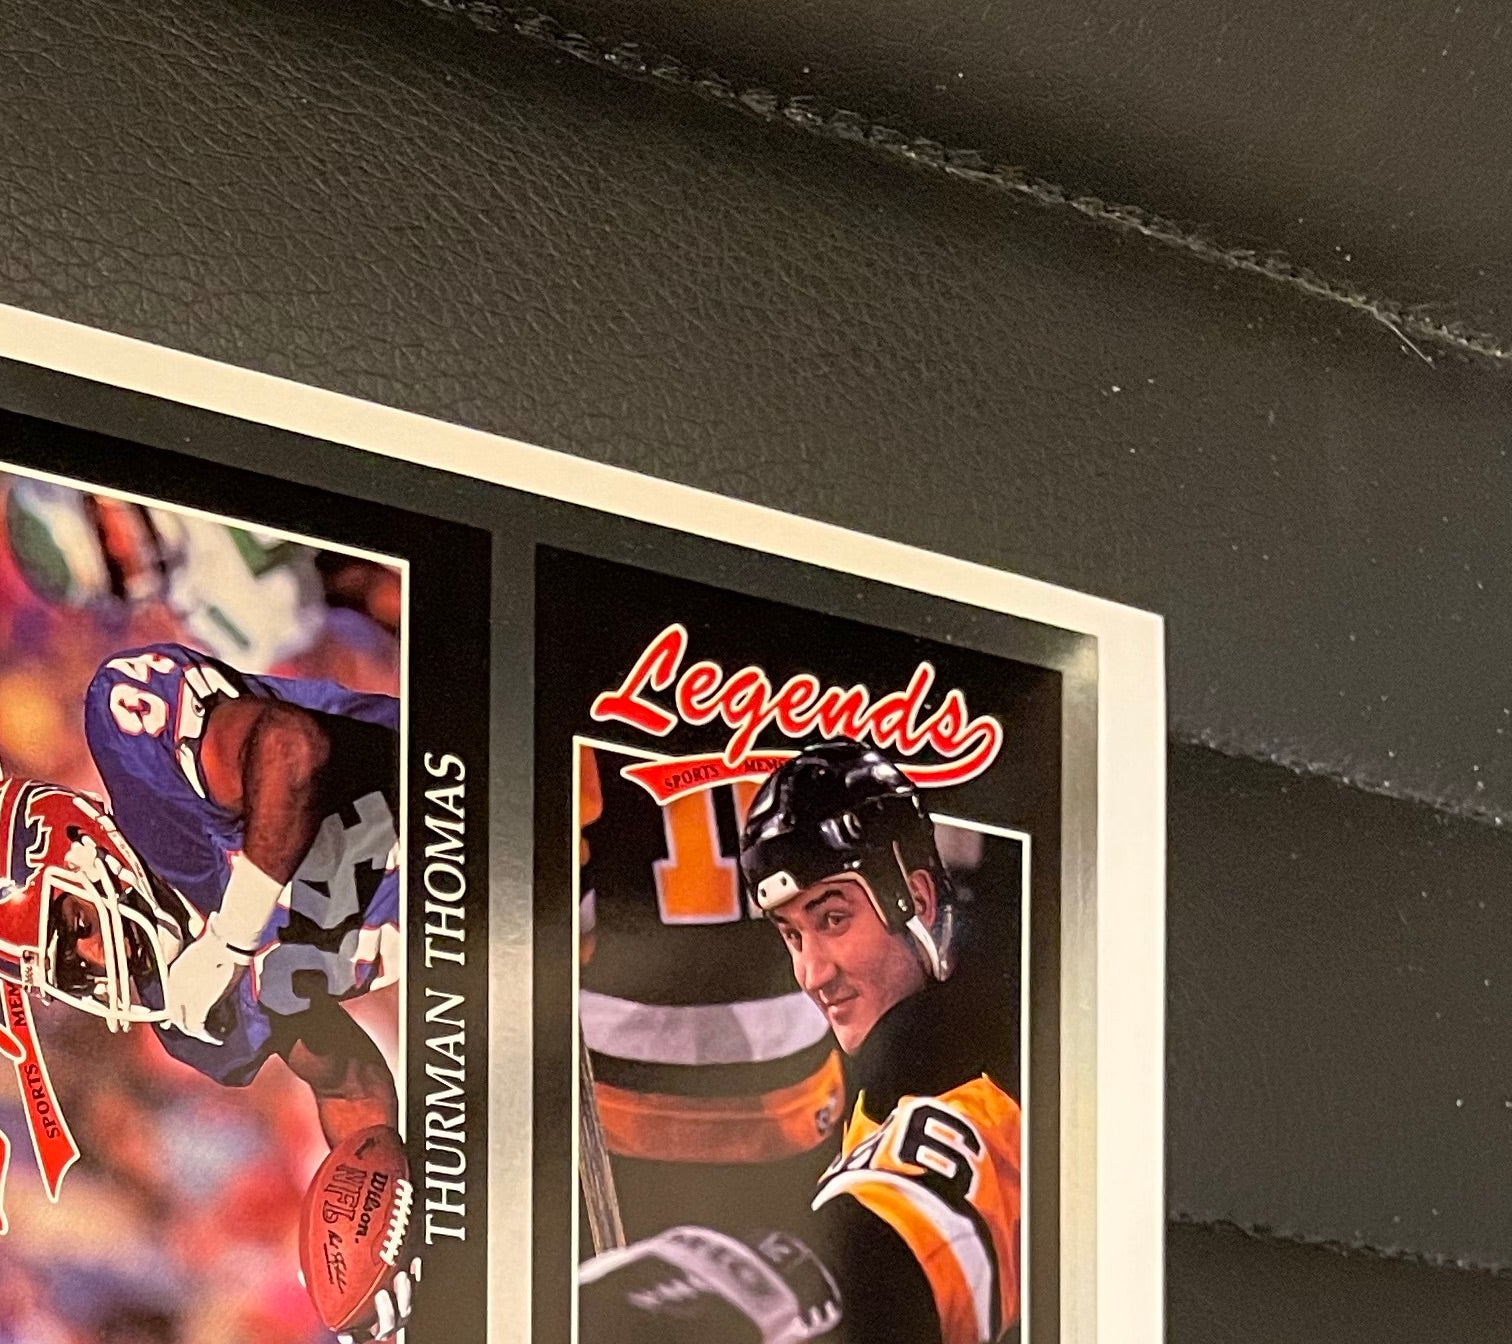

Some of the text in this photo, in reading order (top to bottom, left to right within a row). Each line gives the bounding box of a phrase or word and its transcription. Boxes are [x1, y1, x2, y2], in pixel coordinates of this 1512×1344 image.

[591, 623, 1003, 787] Legends
[664, 764, 719, 789] SPORTS
[423, 752, 467, 1246] THURMAN THOMAS
[22, 1063, 61, 1139] SPORTS
[322, 1163, 367, 1224] NFL
